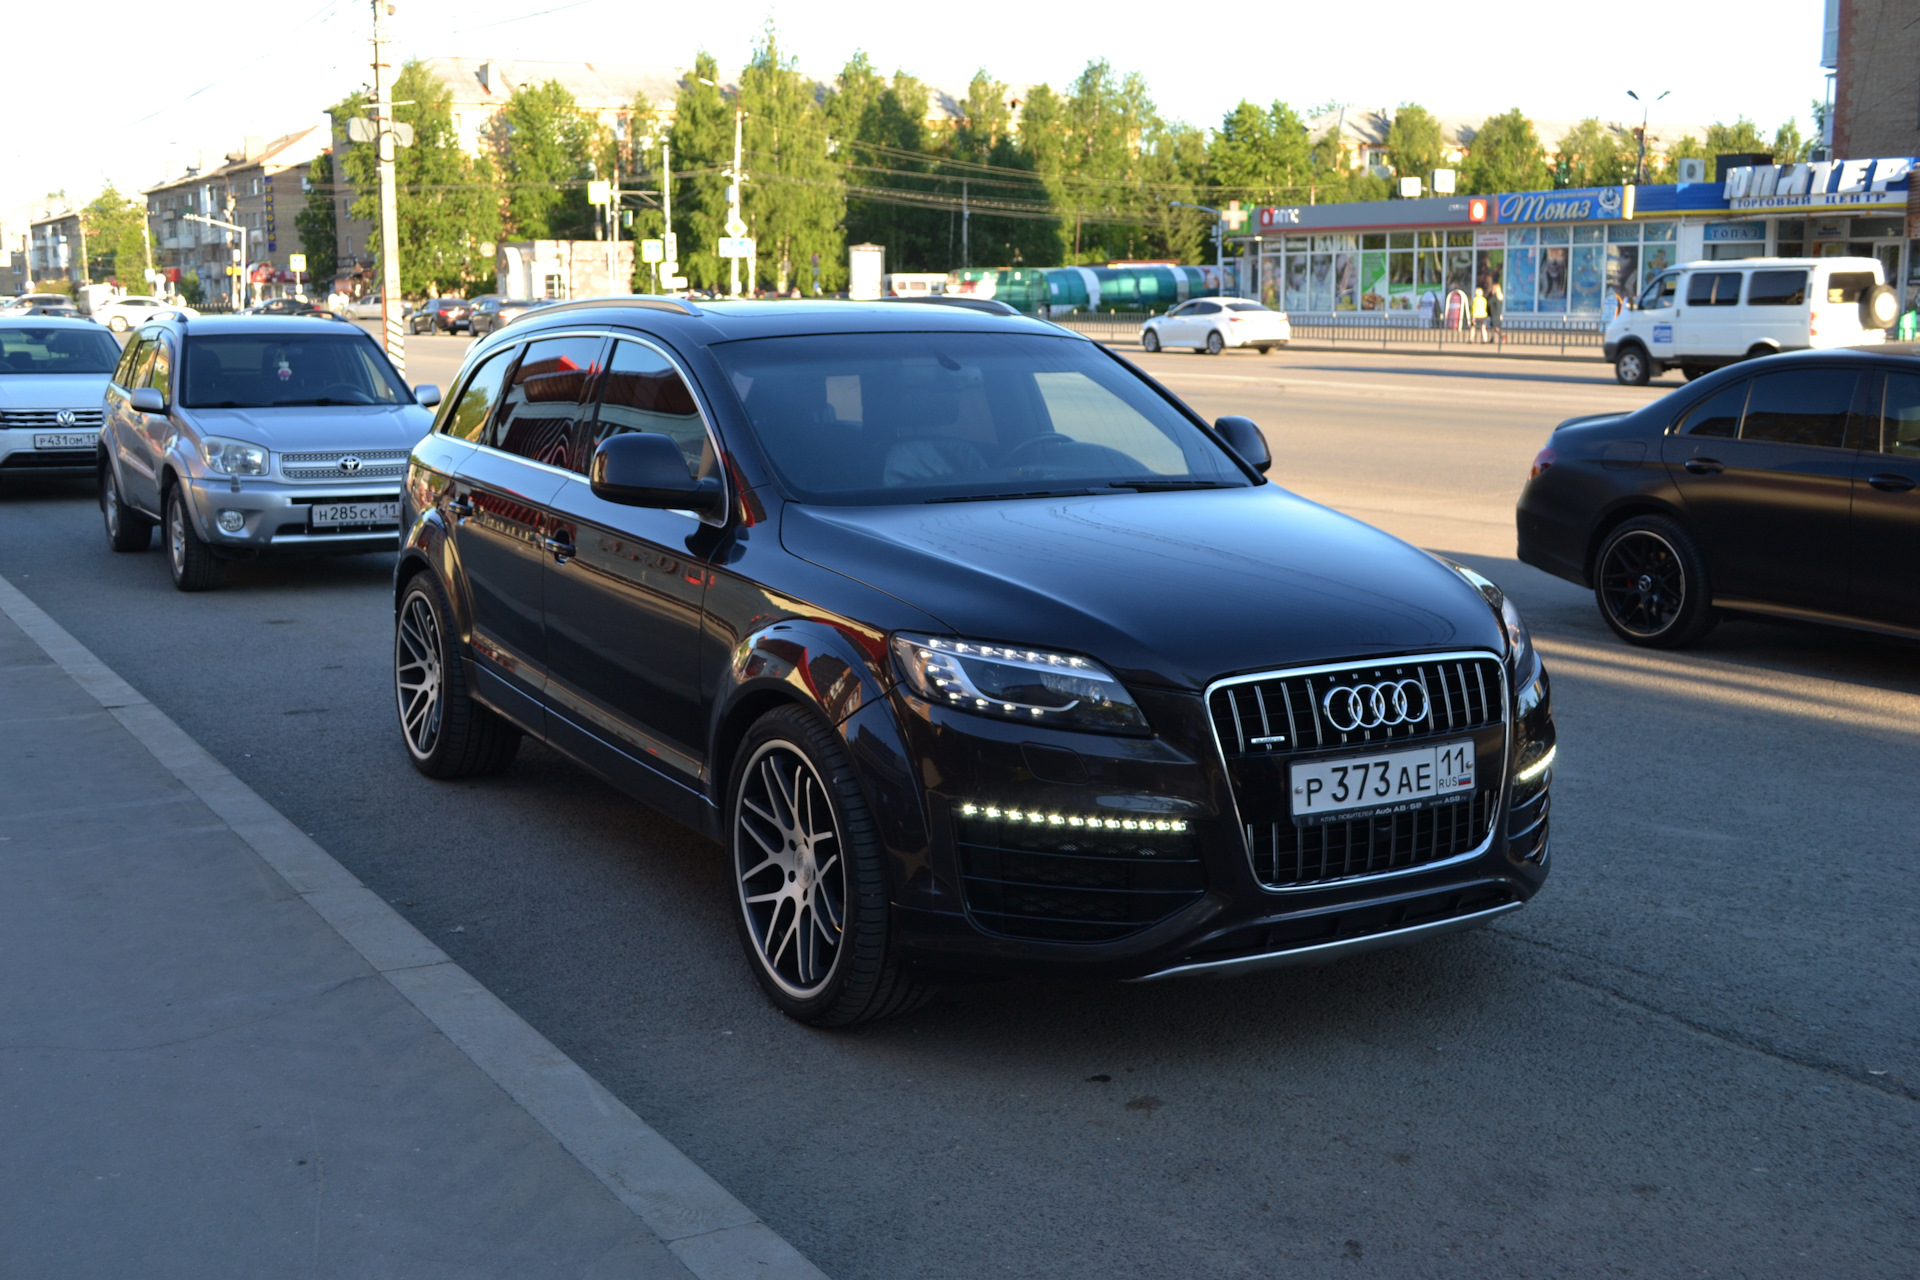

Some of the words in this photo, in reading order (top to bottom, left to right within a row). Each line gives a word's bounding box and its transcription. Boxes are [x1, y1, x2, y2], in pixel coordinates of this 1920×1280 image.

[1724, 158, 1910, 199] ЮПИТЕР
[1737, 195, 1811, 209] ТОРГОВЫЙ
[1825, 193, 1886, 205] ЦЕНТР
[1273, 208, 1299, 224] МТС
[1711, 228, 1760, 239] ТОПАЗ
[40, 434, 83, 445] Р431ОМ
[86, 434, 96, 442] 11
[319, 505, 377, 520] Н285СК
[382, 504, 396, 515] 11
[1306, 760, 1431, 807] Р373АЕ
[1441, 747, 1464, 776] 11
[1439, 777, 1458, 789] RUS
[1375, 807, 1392, 815] Audi
